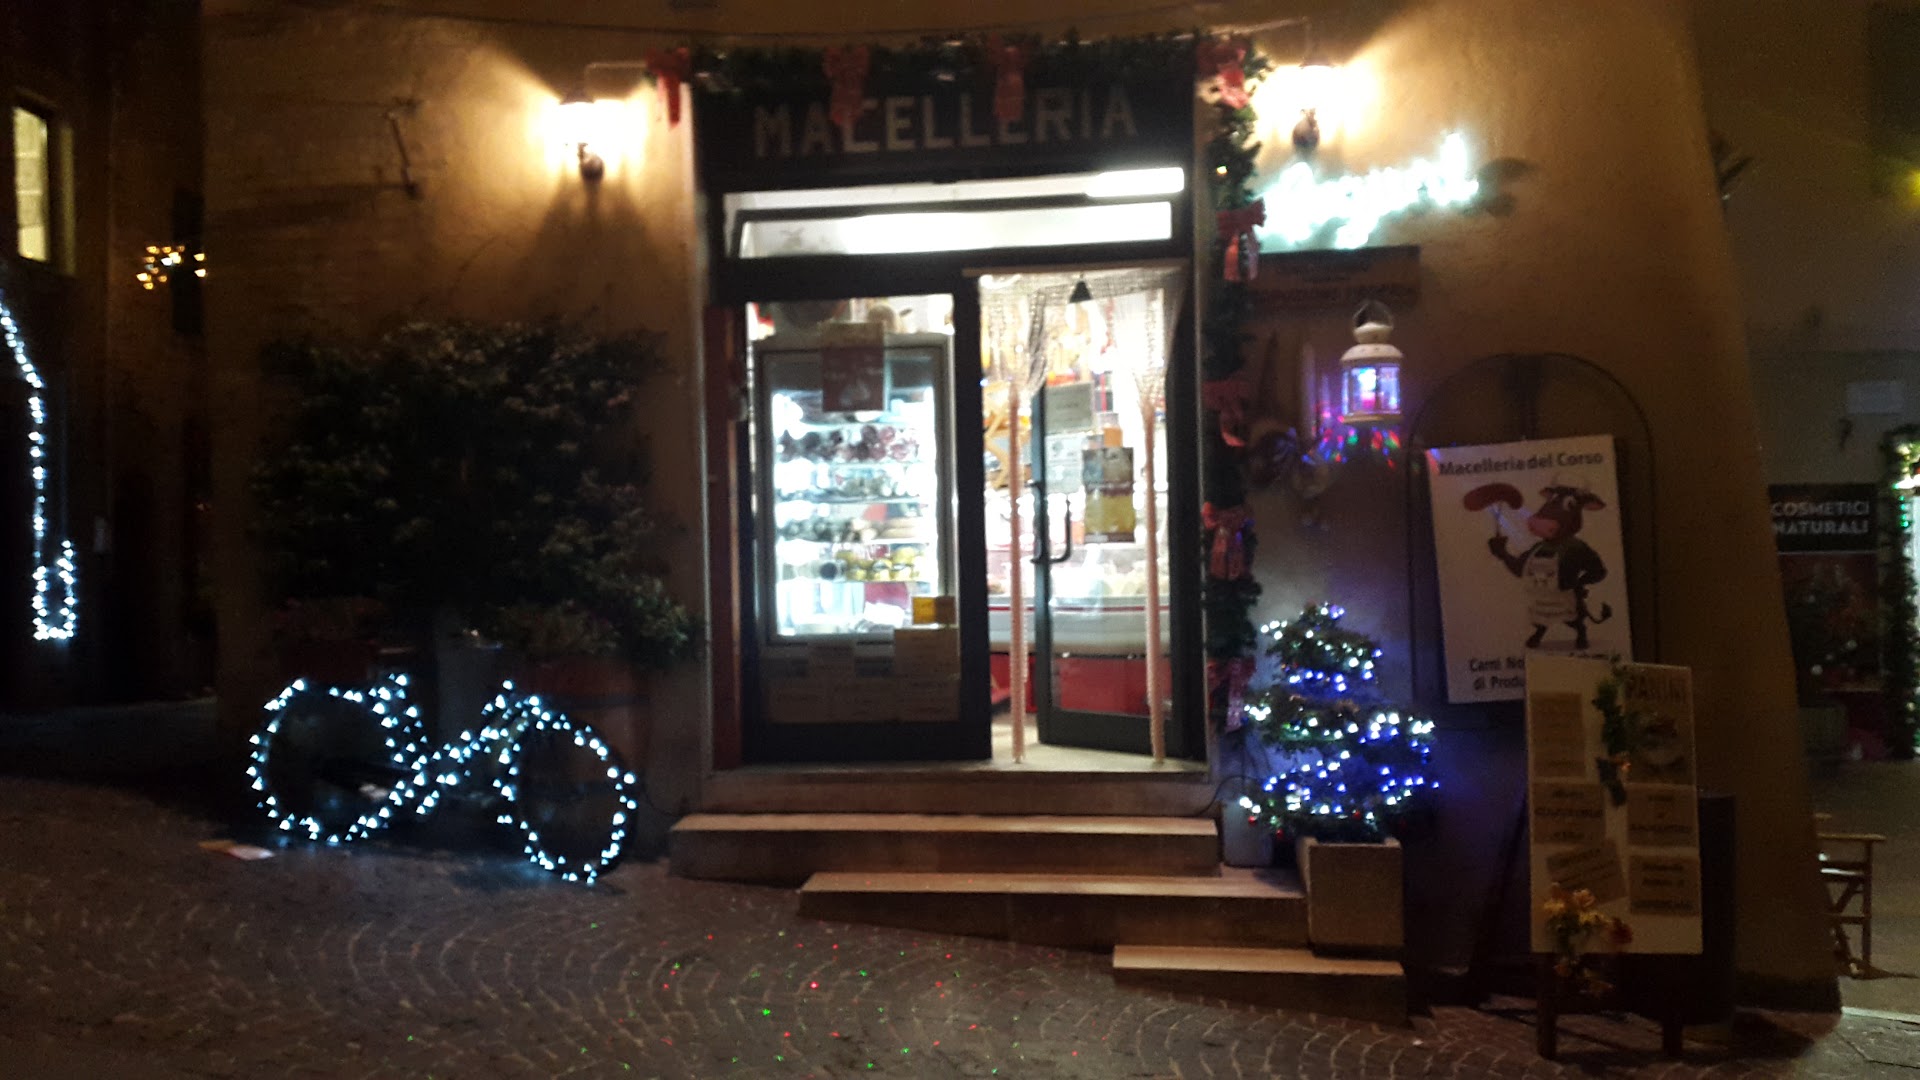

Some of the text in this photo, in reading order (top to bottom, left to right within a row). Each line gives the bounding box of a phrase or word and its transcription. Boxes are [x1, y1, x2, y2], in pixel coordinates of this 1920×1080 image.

[1528, 454, 1553, 469] del
[1556, 452, 1603, 467] Corso
[1771, 501, 1869, 516] COSMETICI
[1773, 519, 1869, 535] NATURALI
[1506, 656, 1525, 670] No
[1491, 675, 1525, 689] Produ
